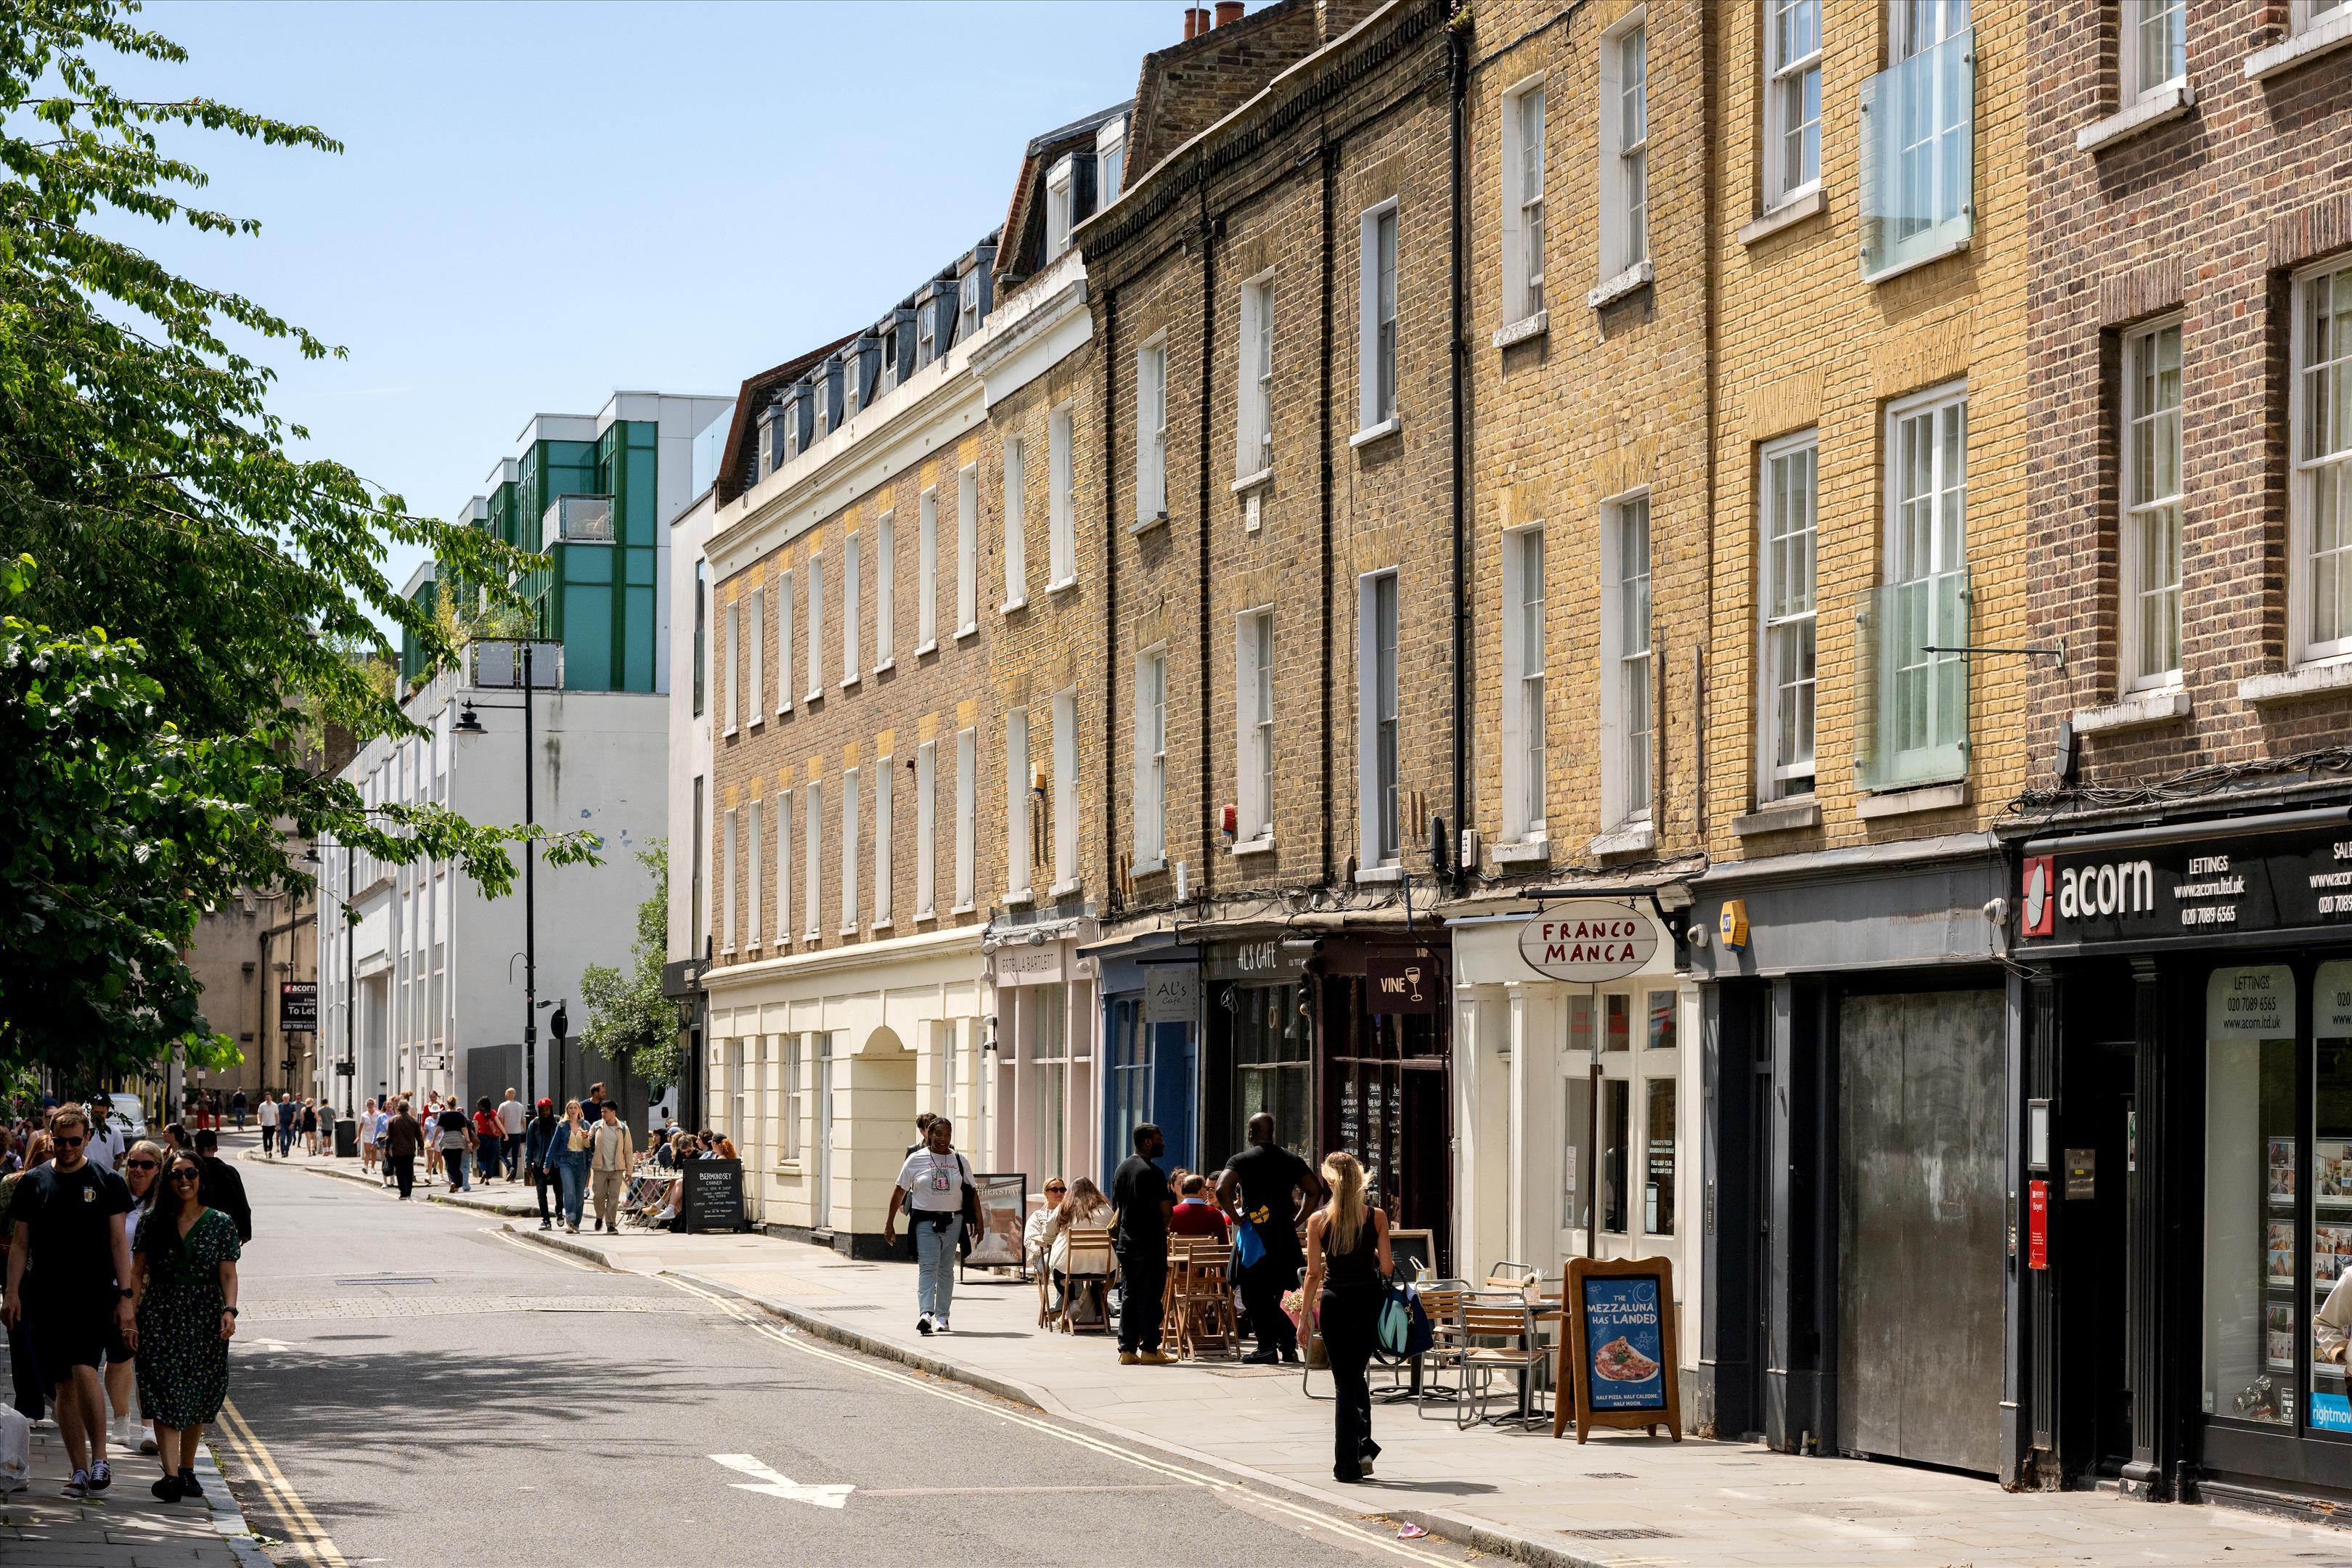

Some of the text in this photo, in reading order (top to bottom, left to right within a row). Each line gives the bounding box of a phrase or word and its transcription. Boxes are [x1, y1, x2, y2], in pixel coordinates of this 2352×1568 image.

[2334, 841, 2352, 859] SALE
[2189, 855, 2229, 875] LETTINGS
[2060, 859, 2155, 918] acorn
[2174, 875, 2245, 898] www.acorn.ltd.uk
[2319, 897, 2334, 913] 020
[2182, 905, 2237, 925] 020 7089 6565
[1543, 921, 1636, 941] FRANCO
[1238, 944, 1254, 971] AL'S
[1257, 942, 1276, 969] CAFE
[1544, 942, 1635, 964] MANCA
[1003, 954, 1053, 973] ESTELLA BARTLETT
[1381, 977, 1405, 993] VINE
[2234, 976, 2270, 990] LETTINGS
[2228, 996, 2276, 1011] 020 7089 6565
[2337, 992, 2351, 1006] 020
[2224, 1015, 2281, 1029] www.acorn.ltd.uk
[1587, 1302, 1654, 1313] MEZZALUNA
[1592, 1313, 1657, 1325] HAS LANDED
[2313, 1405, 2352, 1425] rightmov
